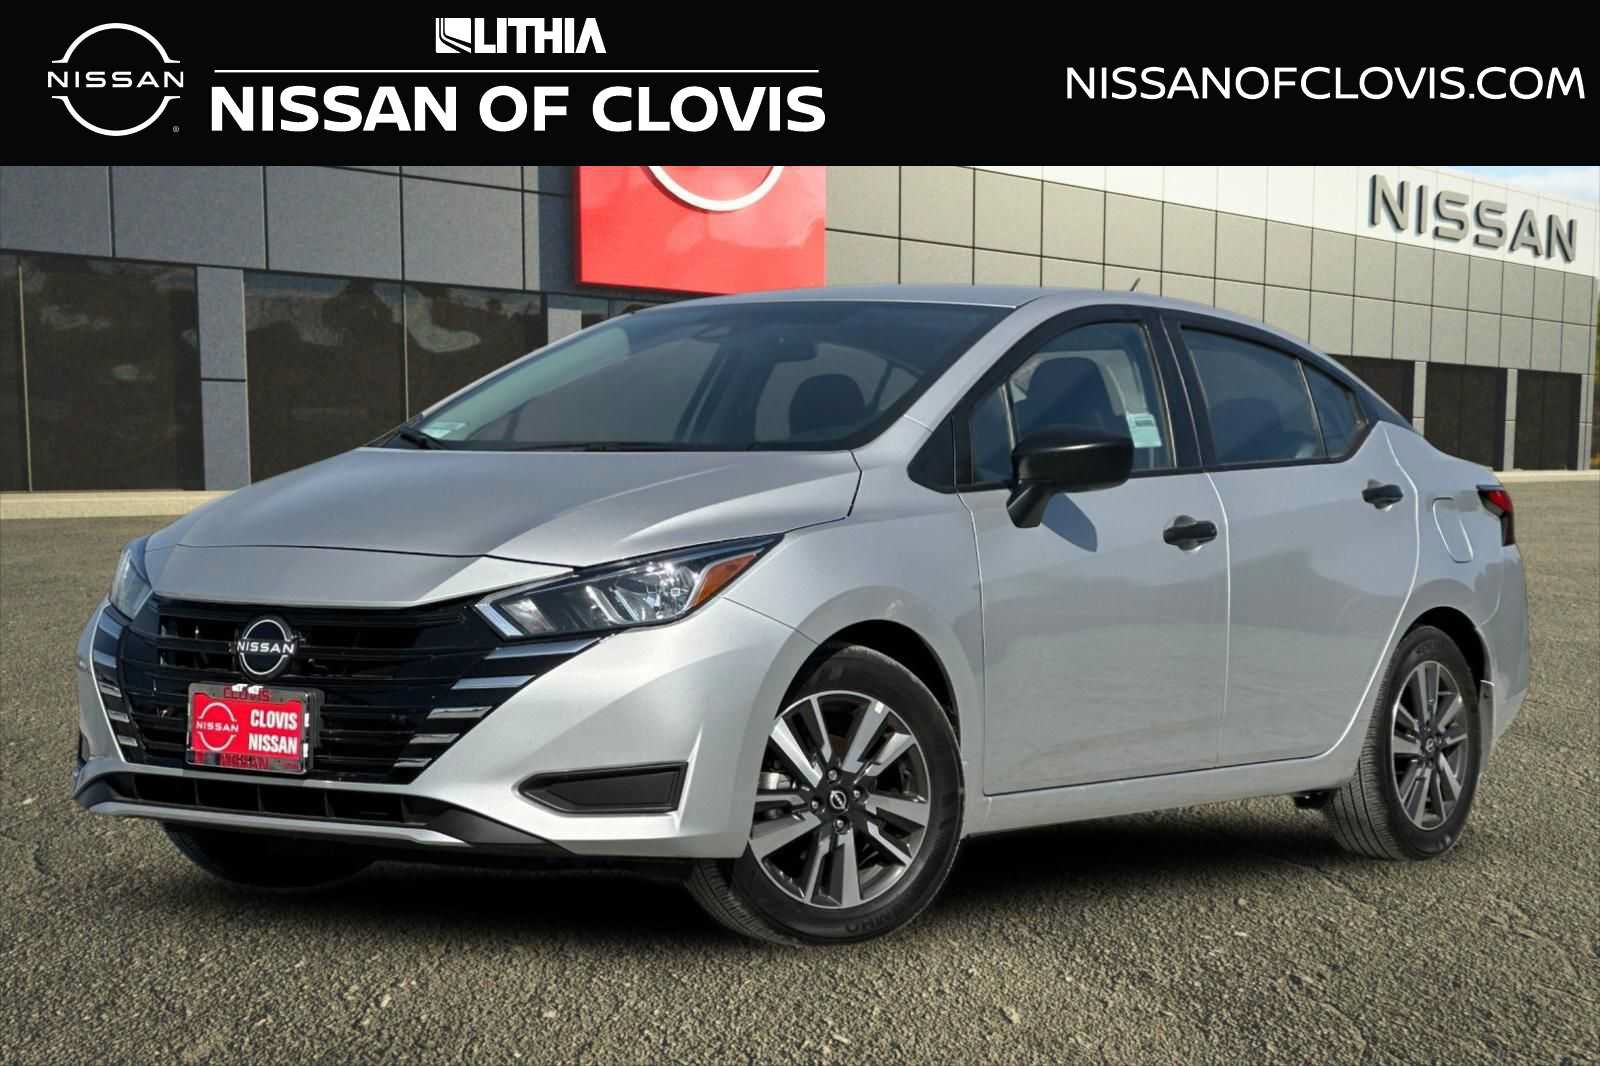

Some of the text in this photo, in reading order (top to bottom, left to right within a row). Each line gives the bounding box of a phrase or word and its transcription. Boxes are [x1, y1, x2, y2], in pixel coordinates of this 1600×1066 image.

[1369, 174, 1578, 263] NISSAN
[236, 640, 295, 655] NISSAN
[195, 721, 239, 733] NISSAN
[250, 709, 298, 730] CLOVIS
[248, 733, 298, 755] NISSAN
